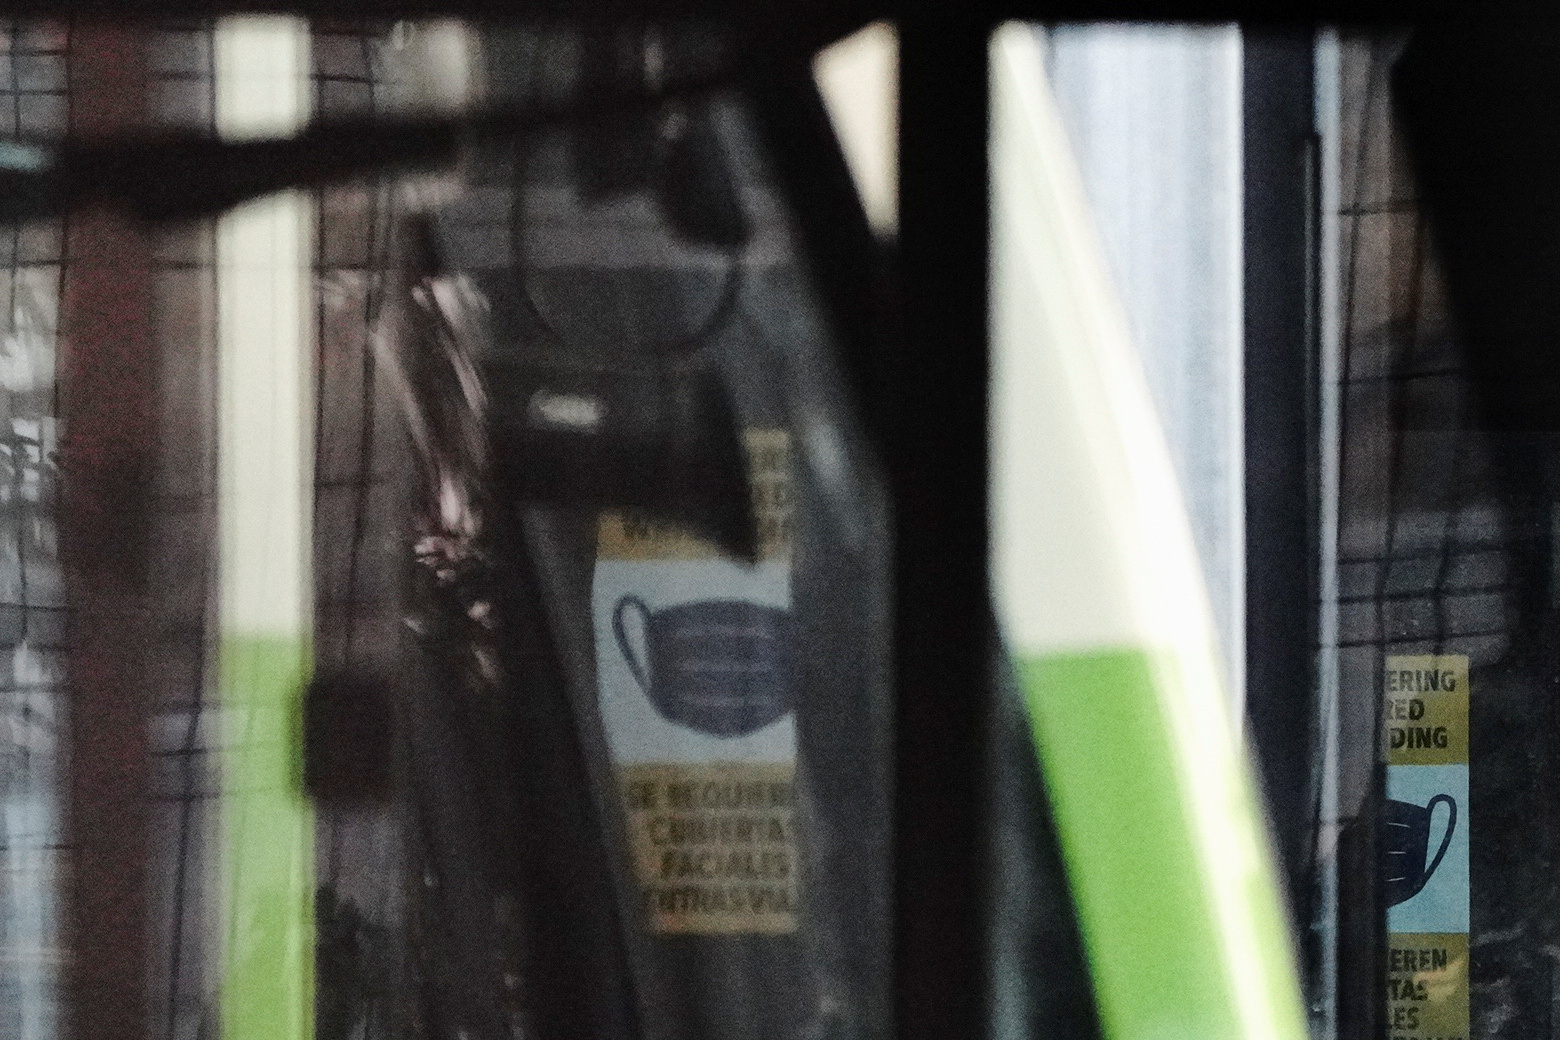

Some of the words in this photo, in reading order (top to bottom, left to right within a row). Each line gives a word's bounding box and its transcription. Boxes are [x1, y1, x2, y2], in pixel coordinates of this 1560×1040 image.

[1386, 669, 1456, 692] ERING
[1390, 727, 1448, 750] DING
[1389, 949, 1448, 971] EREN
[1388, 1007, 1420, 1030] ES
